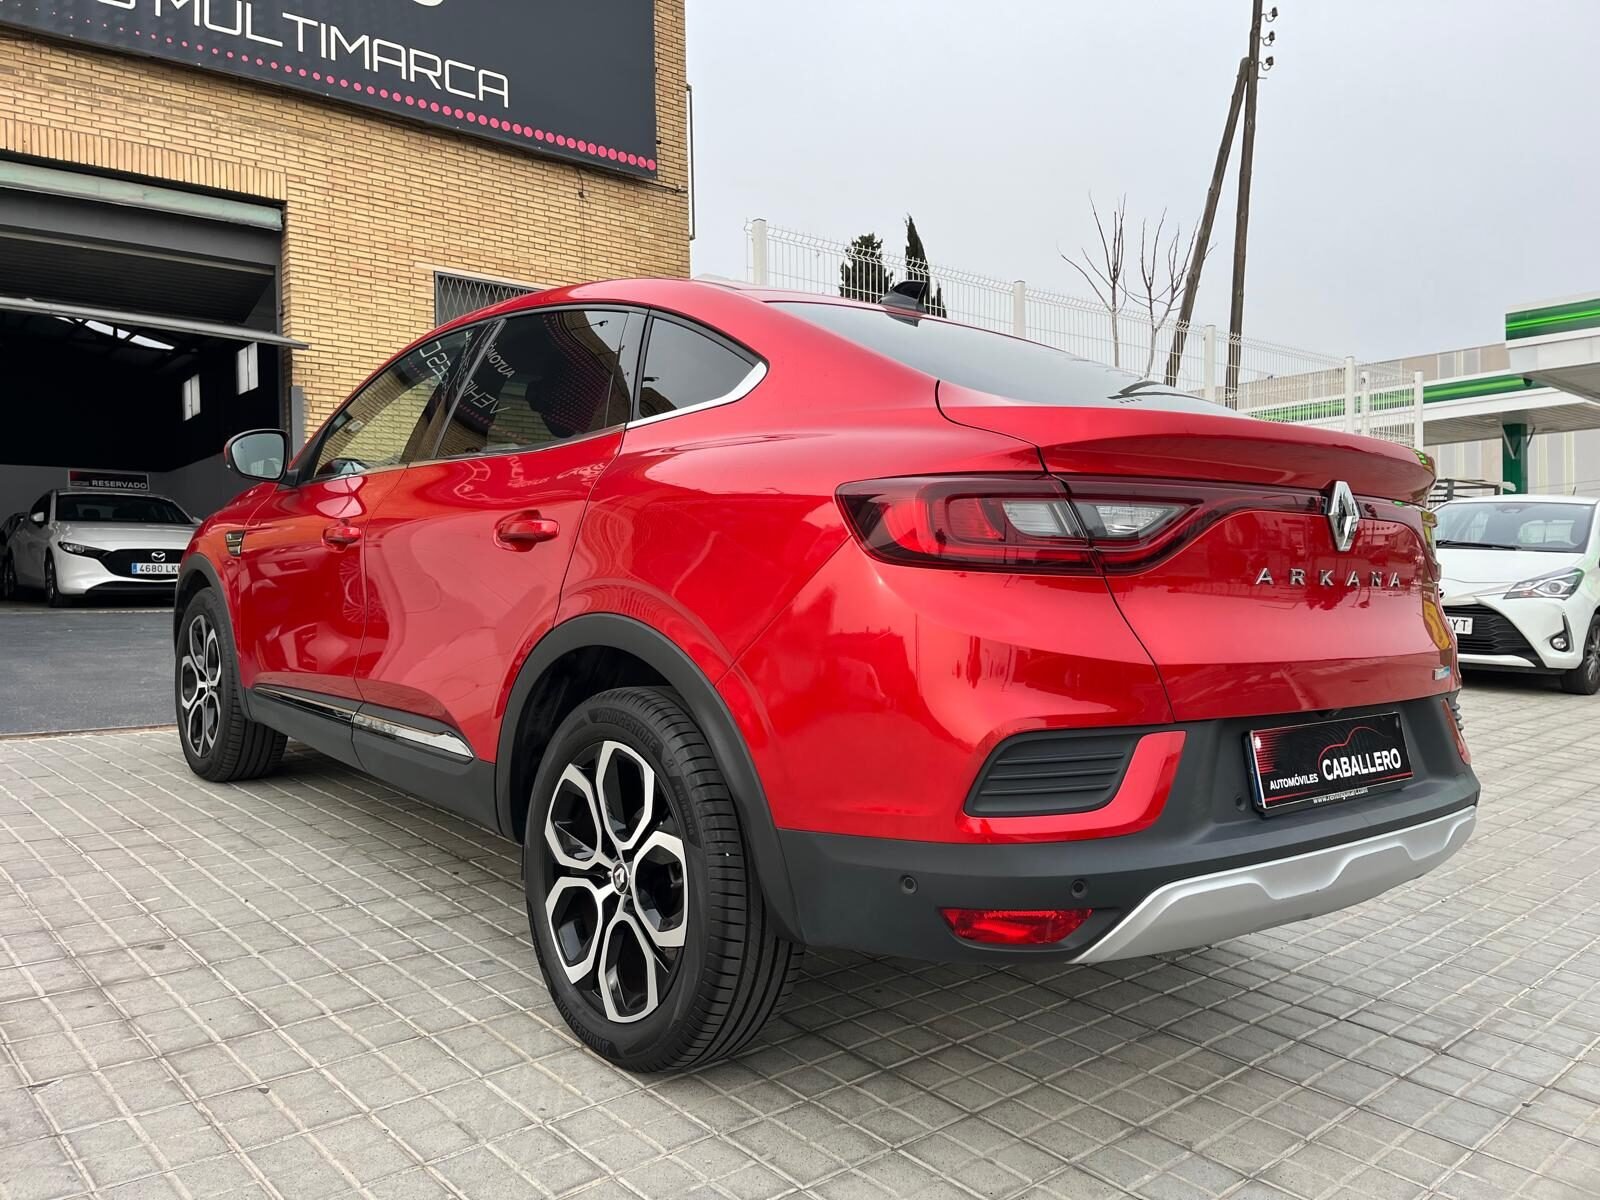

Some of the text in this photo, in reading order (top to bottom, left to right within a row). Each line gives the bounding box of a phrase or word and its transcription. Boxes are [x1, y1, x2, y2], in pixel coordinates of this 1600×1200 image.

[154, 0, 510, 108] MULTIMARCA
[91, 479, 147, 490] RESERVADO
[139, 564, 180, 573] 4680 LK
[1255, 567, 1401, 587] ARKANA
[1447, 618, 1469, 632] YT
[1270, 747, 1402, 791] AUTOMÓVILES CABALLERO
